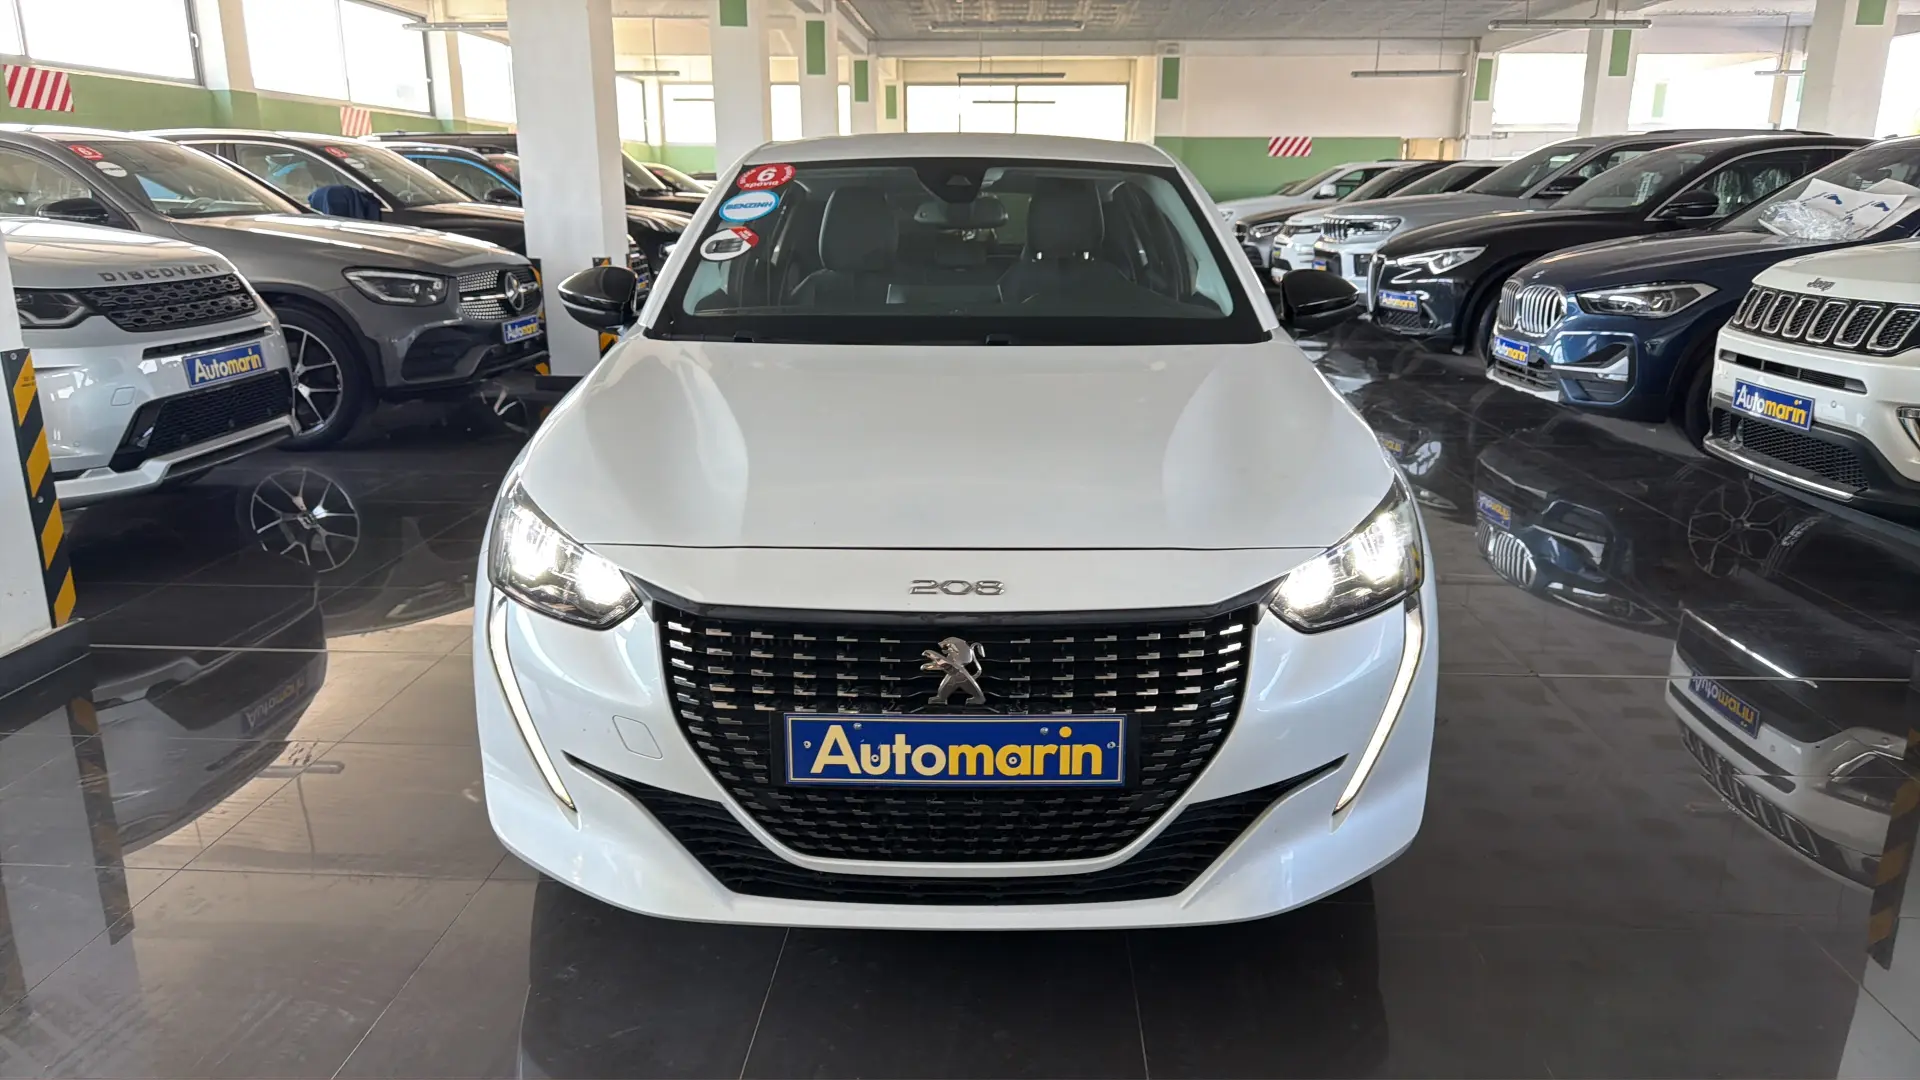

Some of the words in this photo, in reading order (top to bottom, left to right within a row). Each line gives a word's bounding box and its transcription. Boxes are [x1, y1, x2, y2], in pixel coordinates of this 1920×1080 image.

[757, 167, 777, 181] 6
[97, 263, 221, 282] DISCOVERY
[1806, 277, 1836, 291] Jeep
[195, 348, 263, 382] Automarin
[1736, 385, 1806, 424] Automarin
[909, 579, 1005, 596] 208
[810, 724, 1104, 777] Automarin
